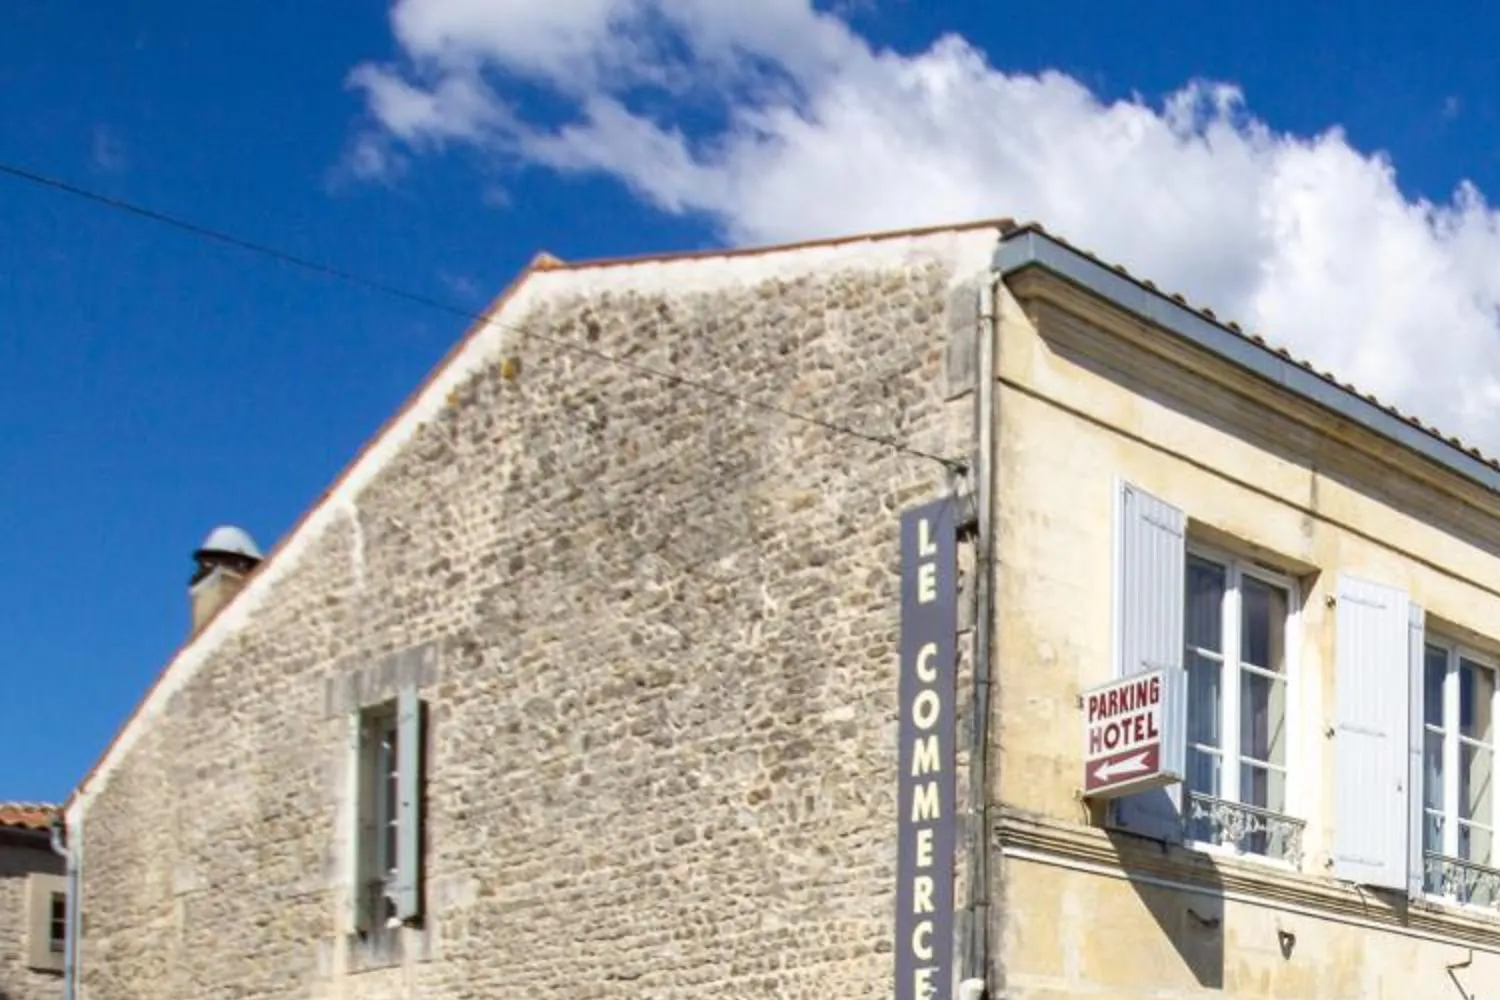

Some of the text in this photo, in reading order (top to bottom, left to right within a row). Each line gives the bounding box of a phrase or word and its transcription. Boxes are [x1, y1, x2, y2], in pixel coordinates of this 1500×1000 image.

[917, 517, 937, 604] LE
[1088, 676, 1159, 724] PARKING
[1089, 711, 1158, 755] HOTEL
